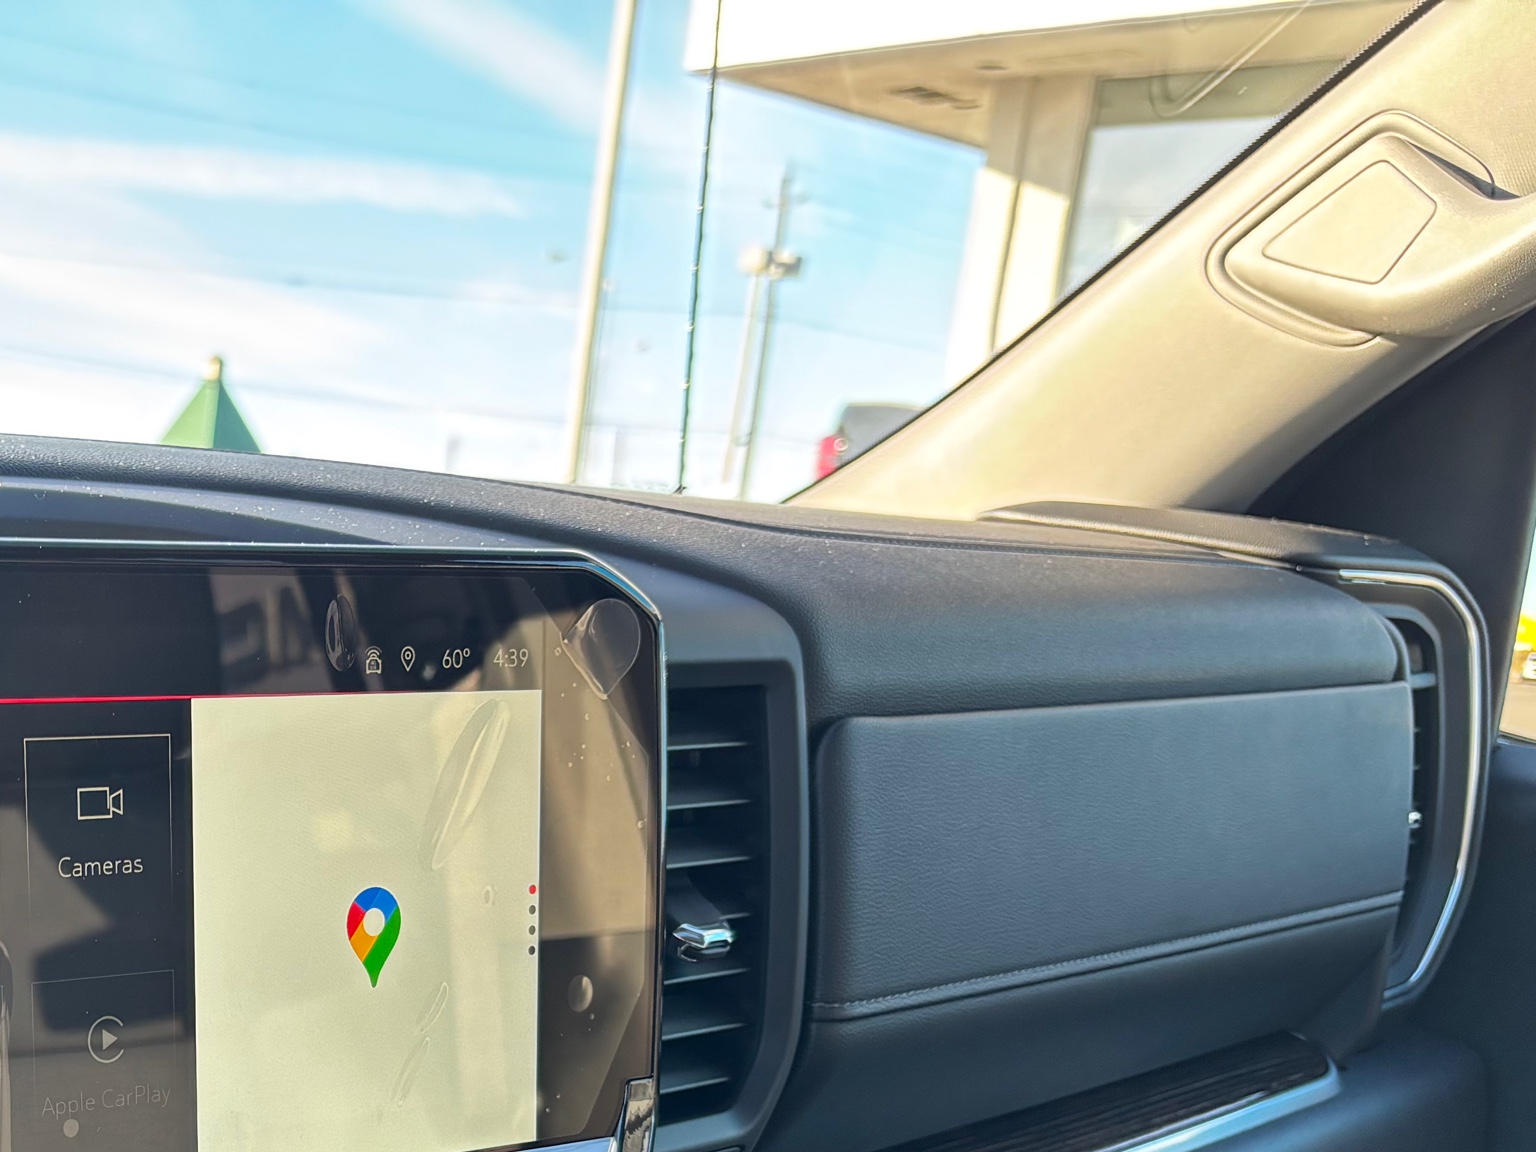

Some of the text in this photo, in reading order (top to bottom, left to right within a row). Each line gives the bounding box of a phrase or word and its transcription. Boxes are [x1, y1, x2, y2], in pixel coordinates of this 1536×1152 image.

[493, 649, 529, 668] 4:39
[58, 854, 144, 880] Cameras
[41, 1083, 171, 1120] Apple CarPlay
